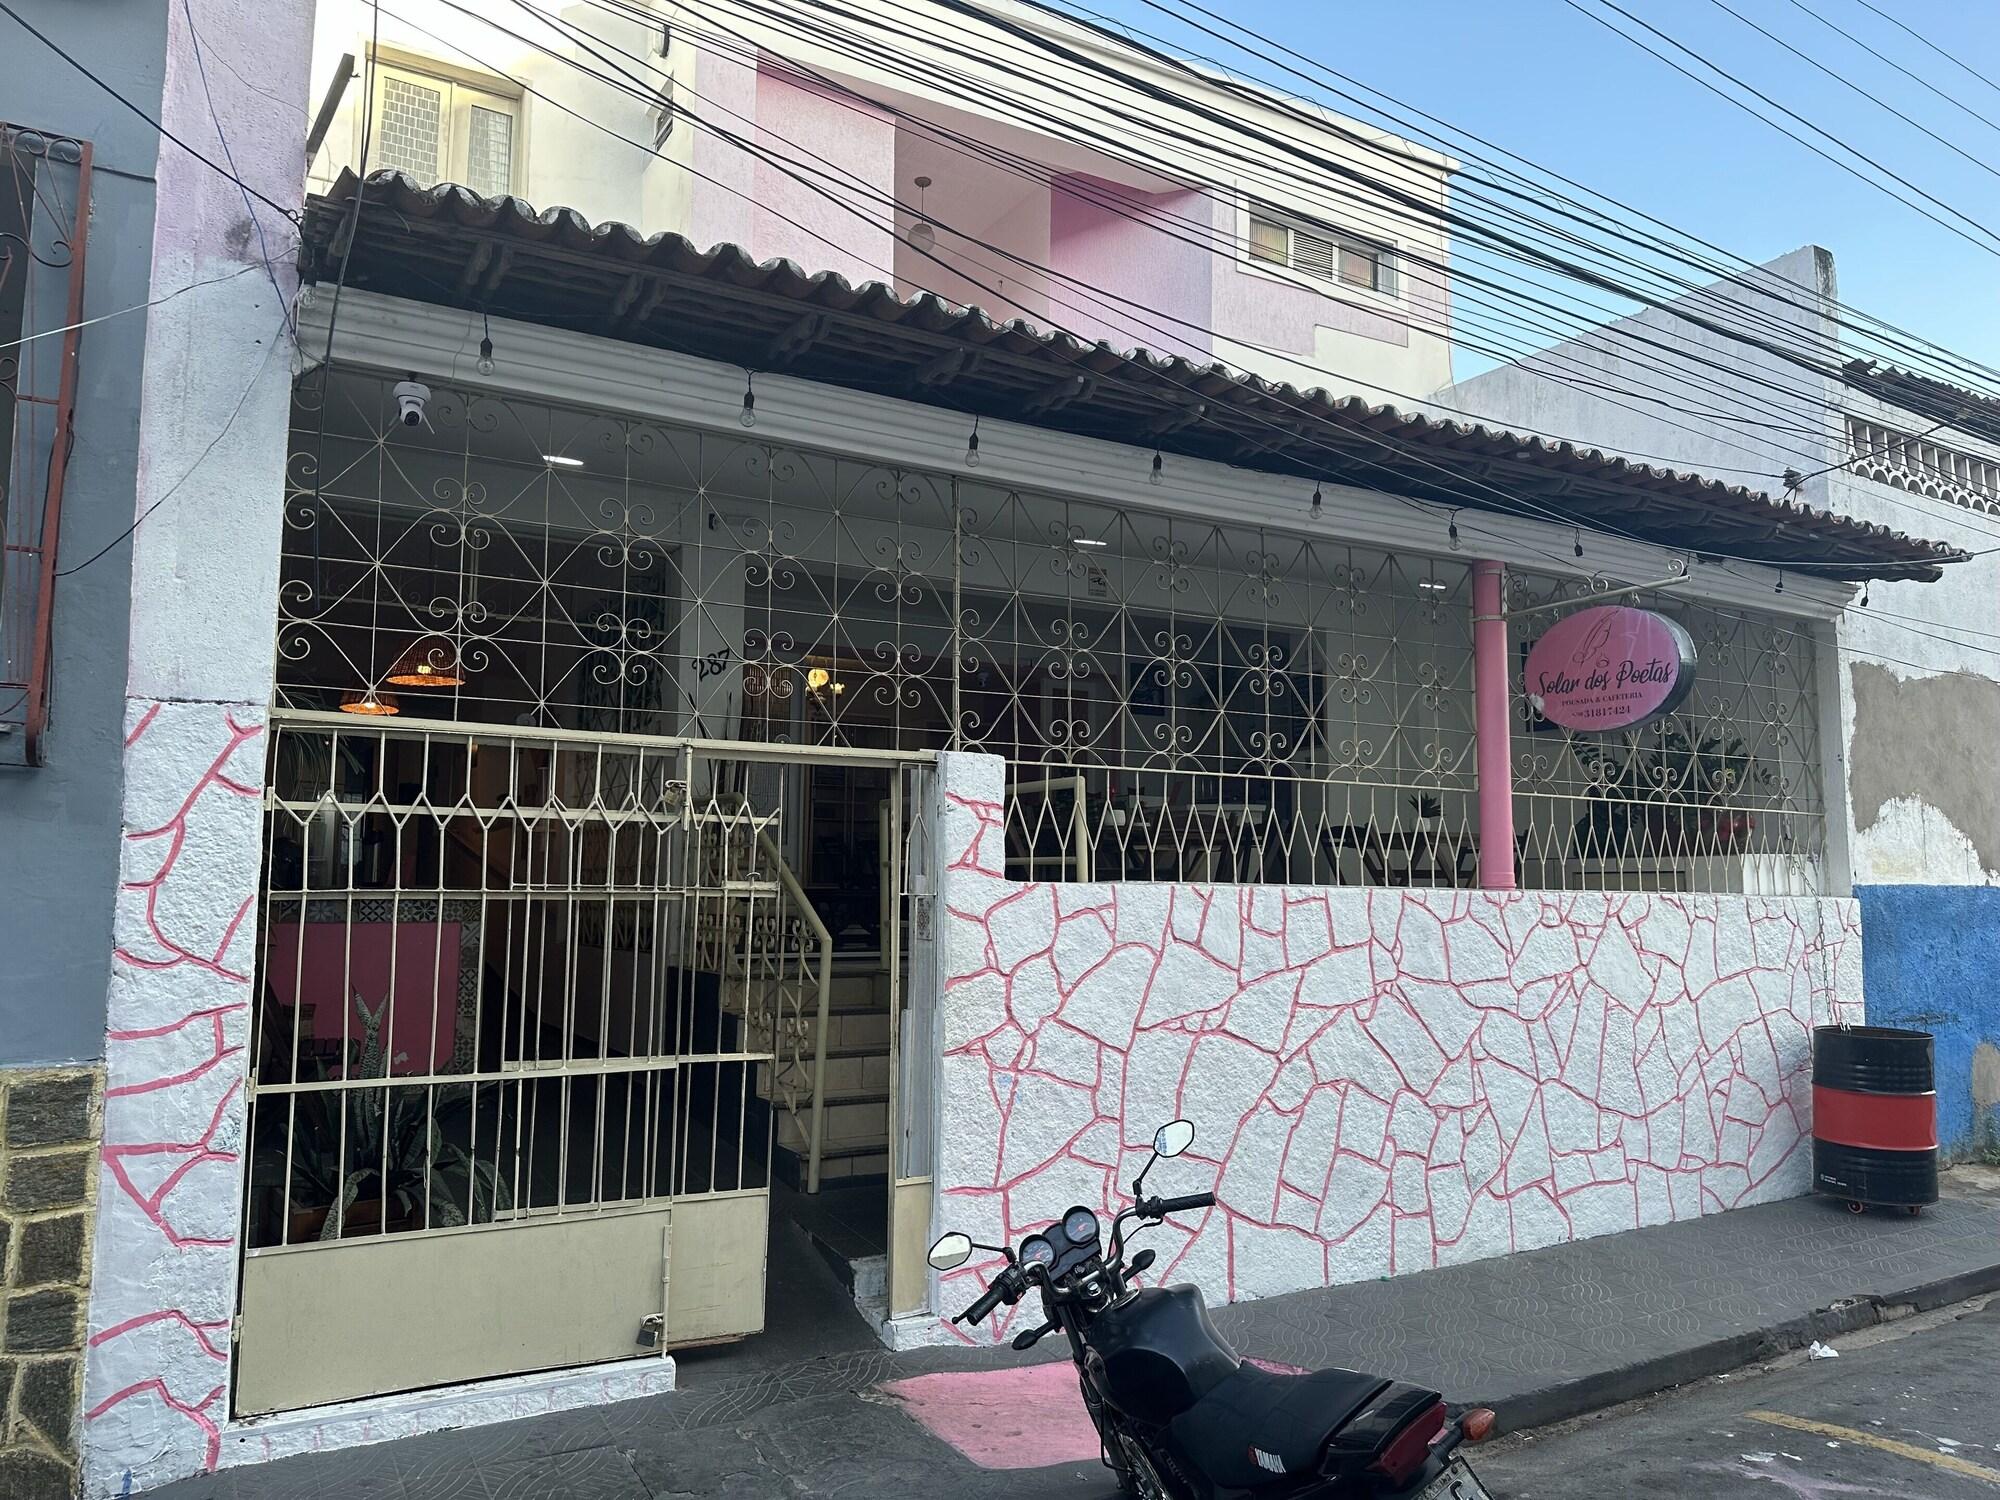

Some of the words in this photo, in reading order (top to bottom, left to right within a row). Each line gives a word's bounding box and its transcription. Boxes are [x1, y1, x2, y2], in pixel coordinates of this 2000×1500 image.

[691, 647, 730, 682] 287
[1534, 671, 1580, 698] Solar
[1584, 669, 1611, 691] dos
[1616, 658, 1674, 689] Poetas
[1602, 691, 1643, 703] CAFETERIA
[1254, 1447, 1287, 1474] YAMAHA
